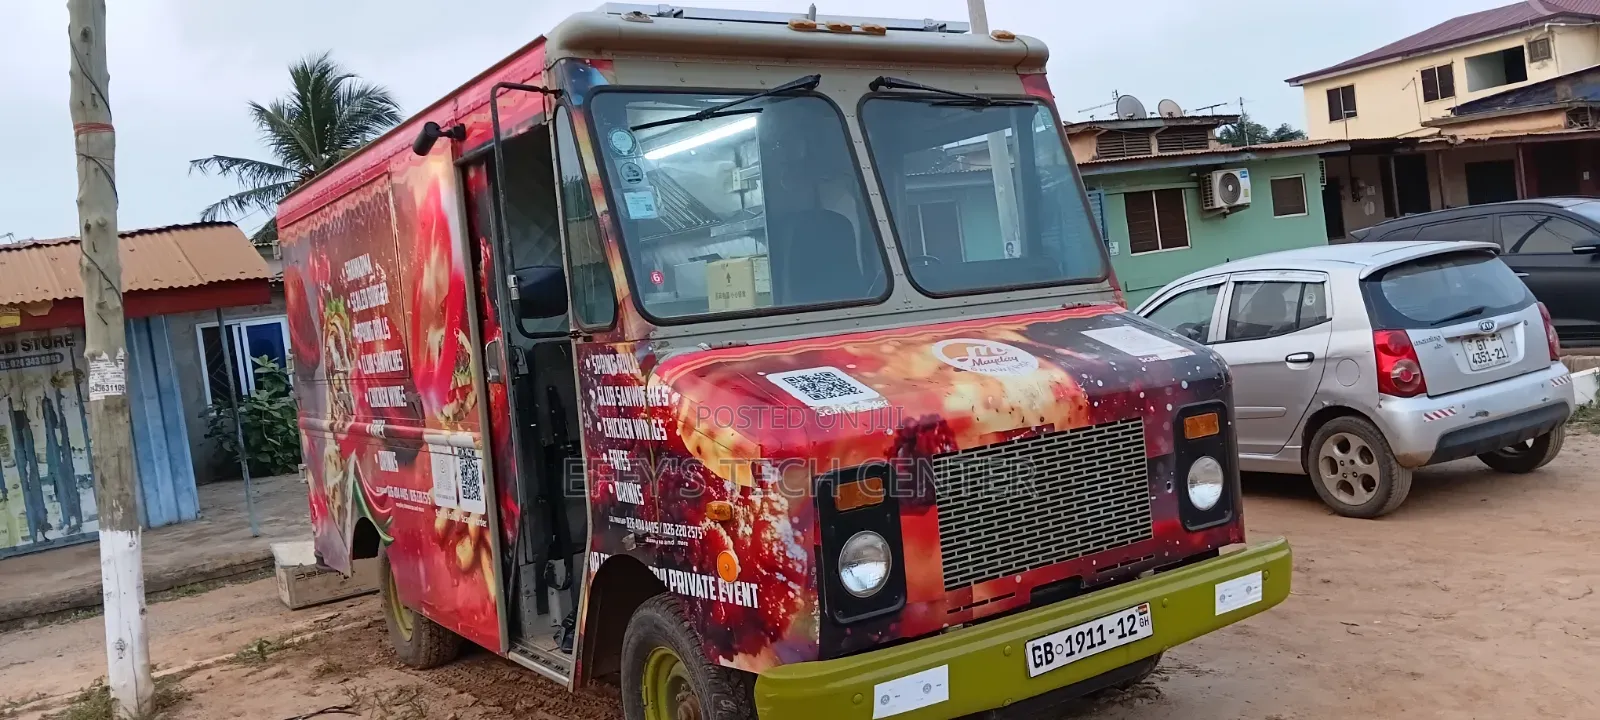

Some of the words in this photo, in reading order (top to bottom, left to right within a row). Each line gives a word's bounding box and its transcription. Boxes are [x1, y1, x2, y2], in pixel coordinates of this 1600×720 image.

[21, 334, 75, 352] STORE
[1476, 339, 1487, 351] GT
[972, 355, 1019, 367] Mayday
[1472, 347, 1507, 365] 4351-21
[596, 385, 618, 407] CLUB
[602, 417, 635, 440] CHICKEN
[632, 419, 668, 440] WINGS
[608, 449, 631, 471] FRIES
[614, 481, 645, 506] DRINKS
[663, 523, 675, 536] 026
[675, 524, 687, 537] 220
[687, 525, 703, 540] 2575
[668, 569, 717, 601] PRIVATE
[717, 577, 759, 609] EVENT
[1031, 641, 1055, 669] GB
[1065, 613, 1138, 658] 1911-12
[1139, 616, 1150, 628] GH
